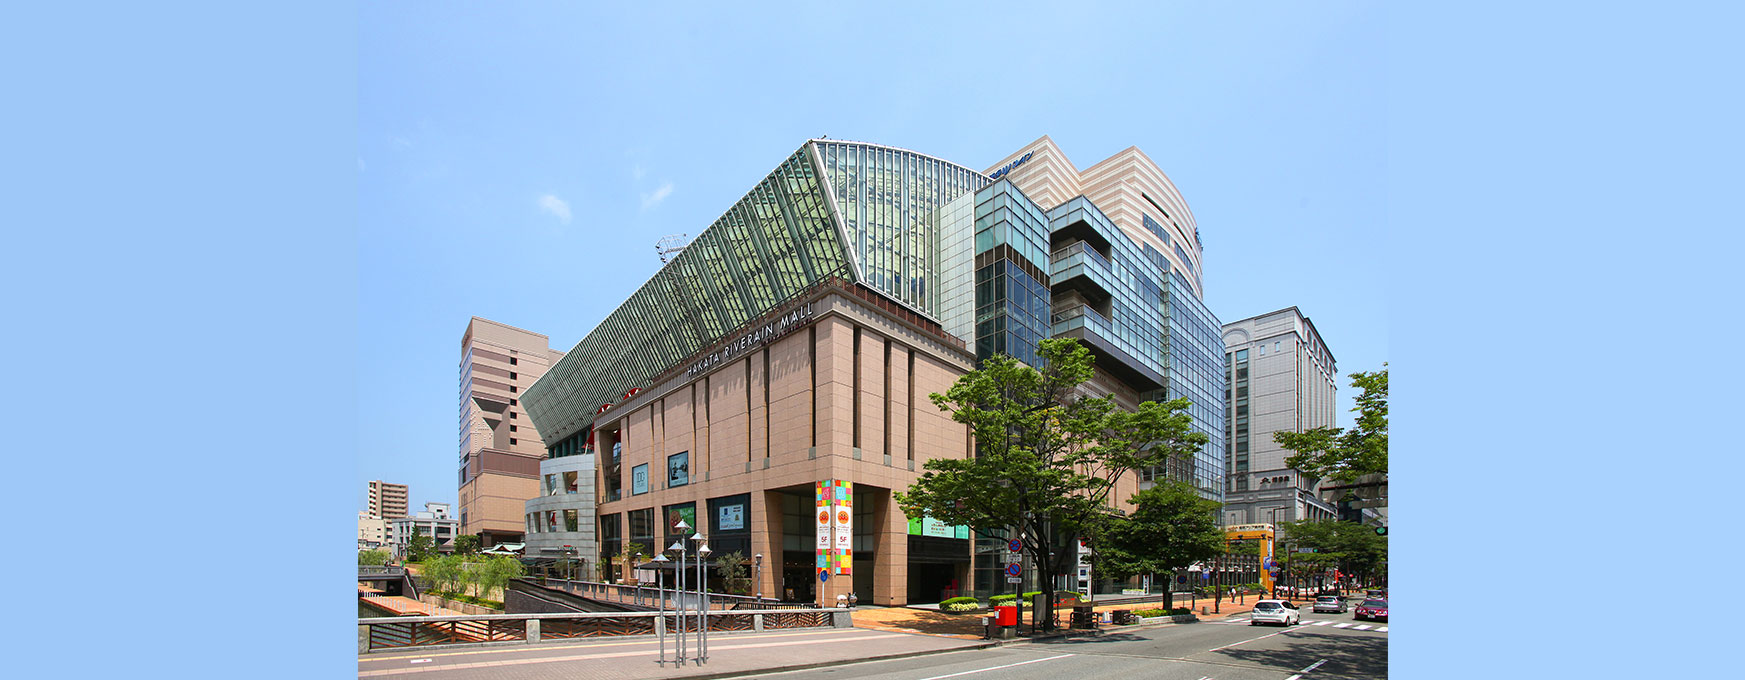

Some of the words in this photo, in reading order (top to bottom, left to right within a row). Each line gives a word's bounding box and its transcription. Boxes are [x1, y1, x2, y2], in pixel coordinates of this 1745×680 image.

[687, 354, 720, 377] HAKATA
[724, 323, 773, 358] RIVERAIN
[780, 302, 813, 330] MALL
